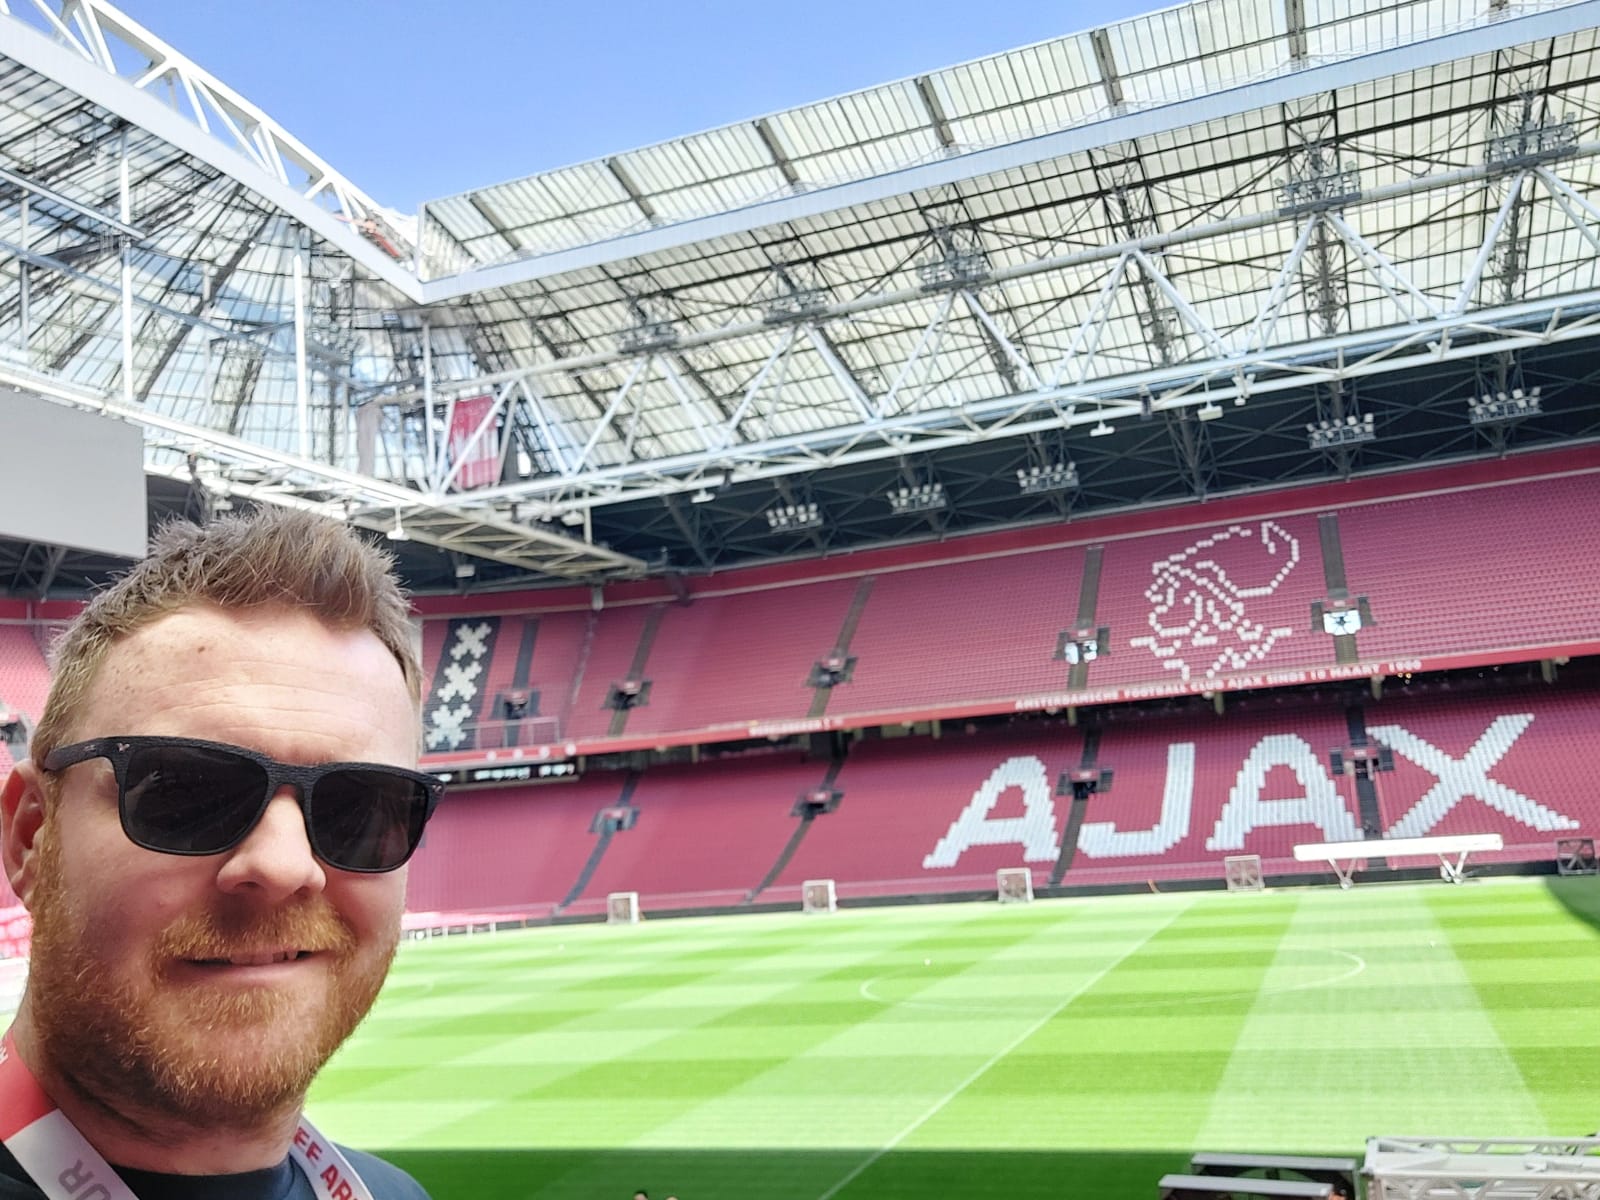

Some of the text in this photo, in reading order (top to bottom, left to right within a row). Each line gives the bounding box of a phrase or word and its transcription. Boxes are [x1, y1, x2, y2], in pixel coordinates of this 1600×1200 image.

[1124, 684, 1187, 699] FOOTBALL
[1190, 679, 1224, 693] CLUB
[1228, 676, 1262, 689] AJAX
[1330, 664, 1380, 678] MAART
[923, 714, 1580, 869] AJAX
